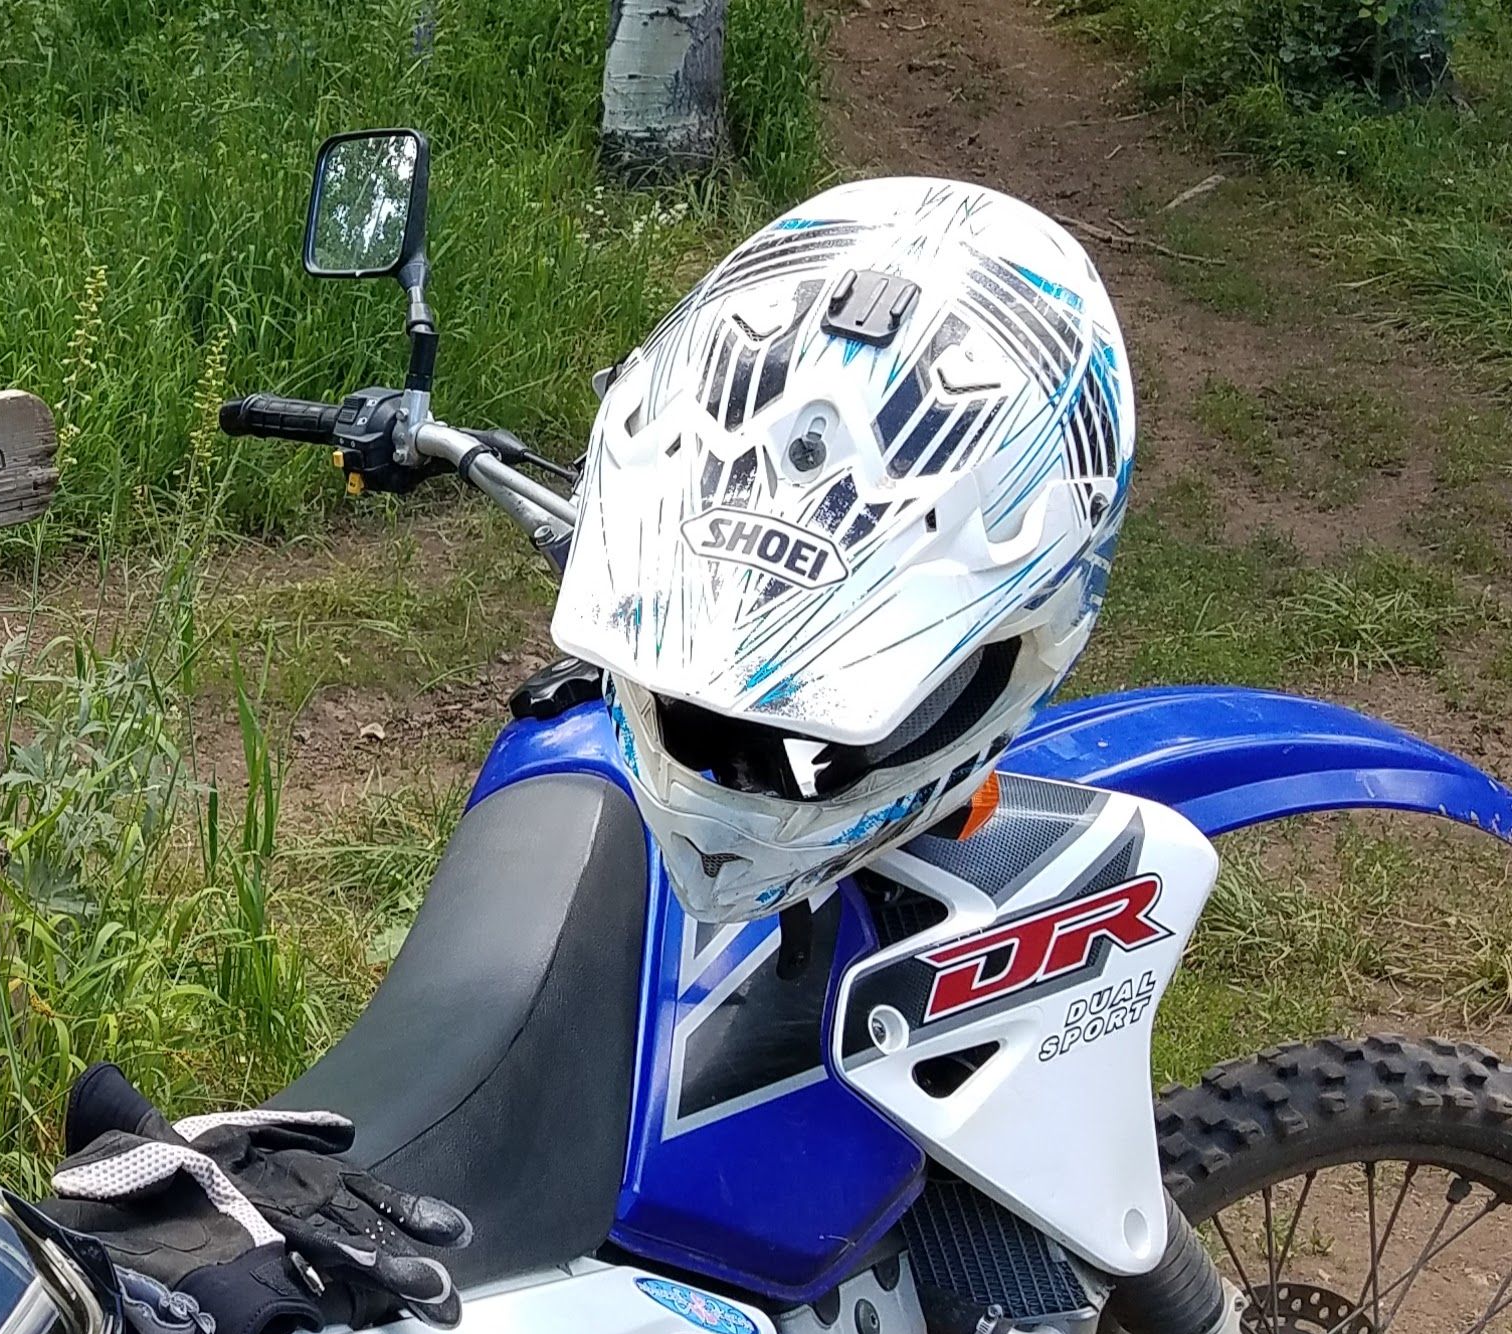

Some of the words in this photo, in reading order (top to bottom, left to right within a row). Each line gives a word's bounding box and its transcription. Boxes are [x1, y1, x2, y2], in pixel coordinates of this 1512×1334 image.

[701, 518, 829, 581] SHOEI
[915, 872, 1176, 1023] DR
[1038, 996, 1153, 1062] SPORT
[1064, 970, 1156, 1028] DUAL
